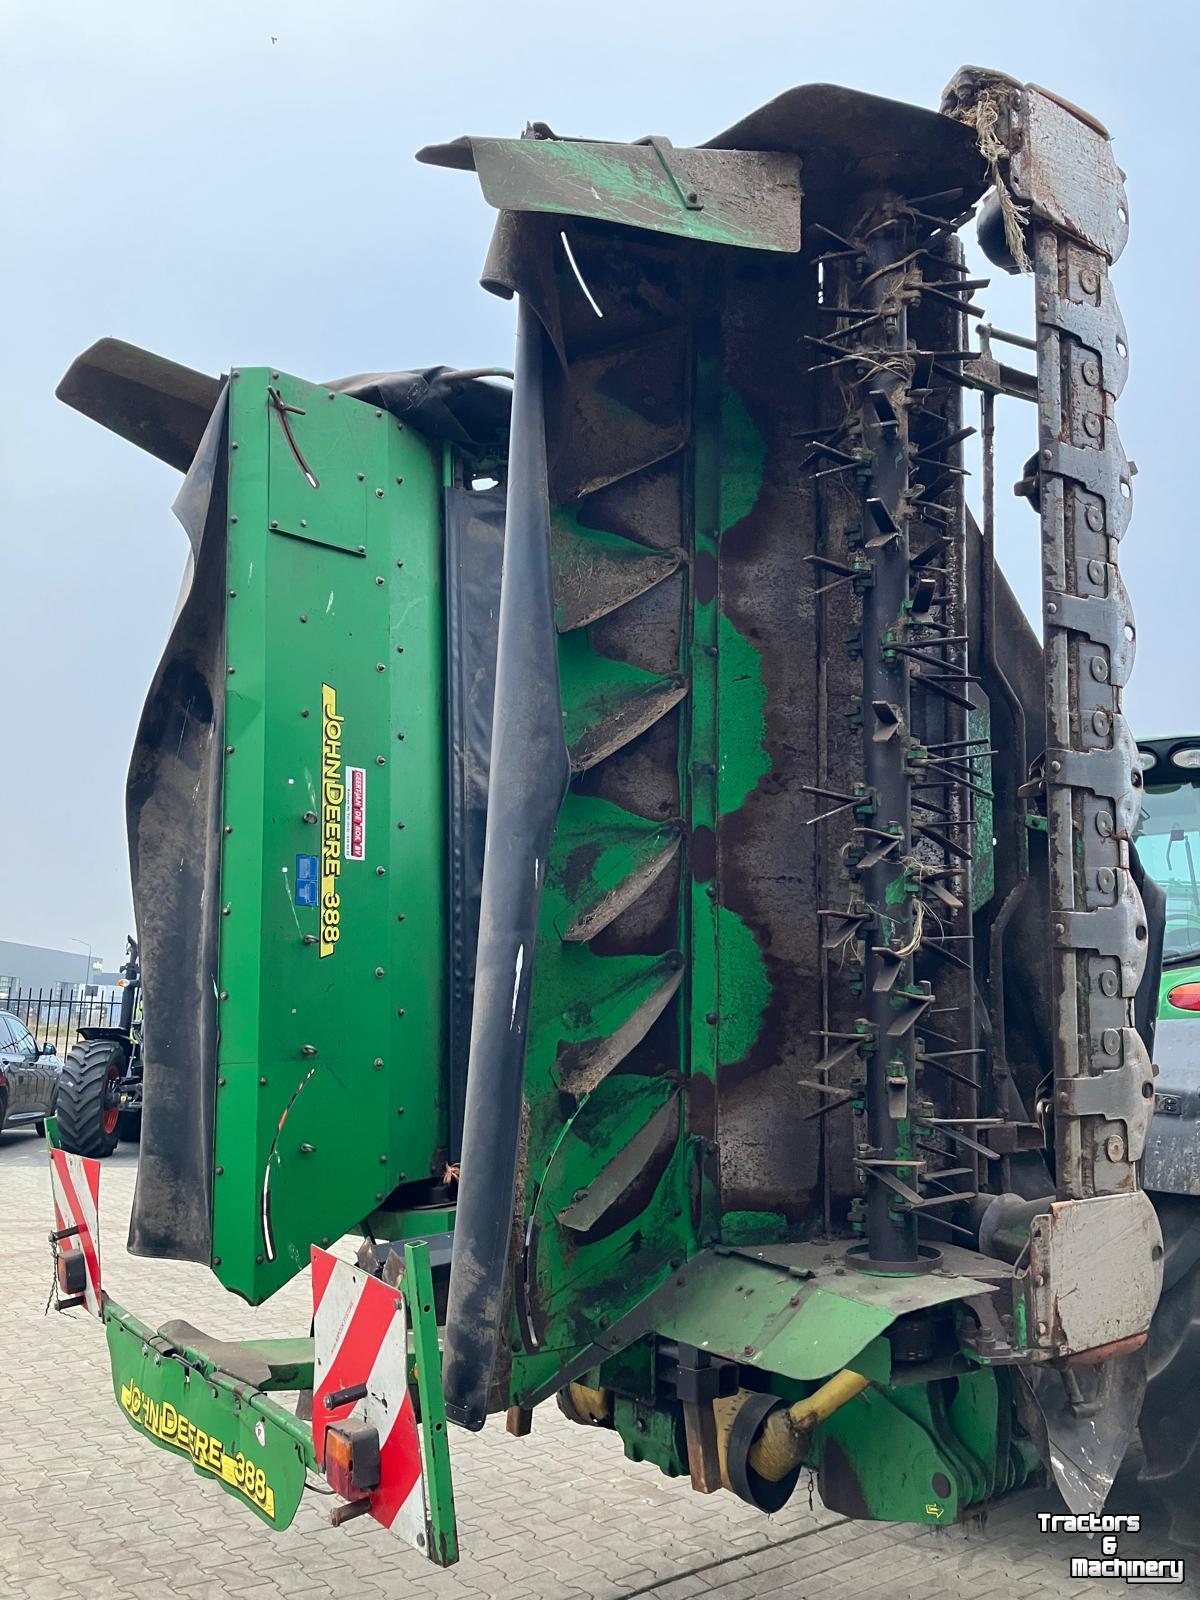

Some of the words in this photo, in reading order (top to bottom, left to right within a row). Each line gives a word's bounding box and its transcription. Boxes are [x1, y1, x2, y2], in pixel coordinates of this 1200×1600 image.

[325, 703, 345, 780] JOHN
[324, 782, 345, 877] DEERE
[323, 892, 340, 943] 388
[161, 1401, 224, 1471] DEERE
[234, 1451, 267, 1505] 388
